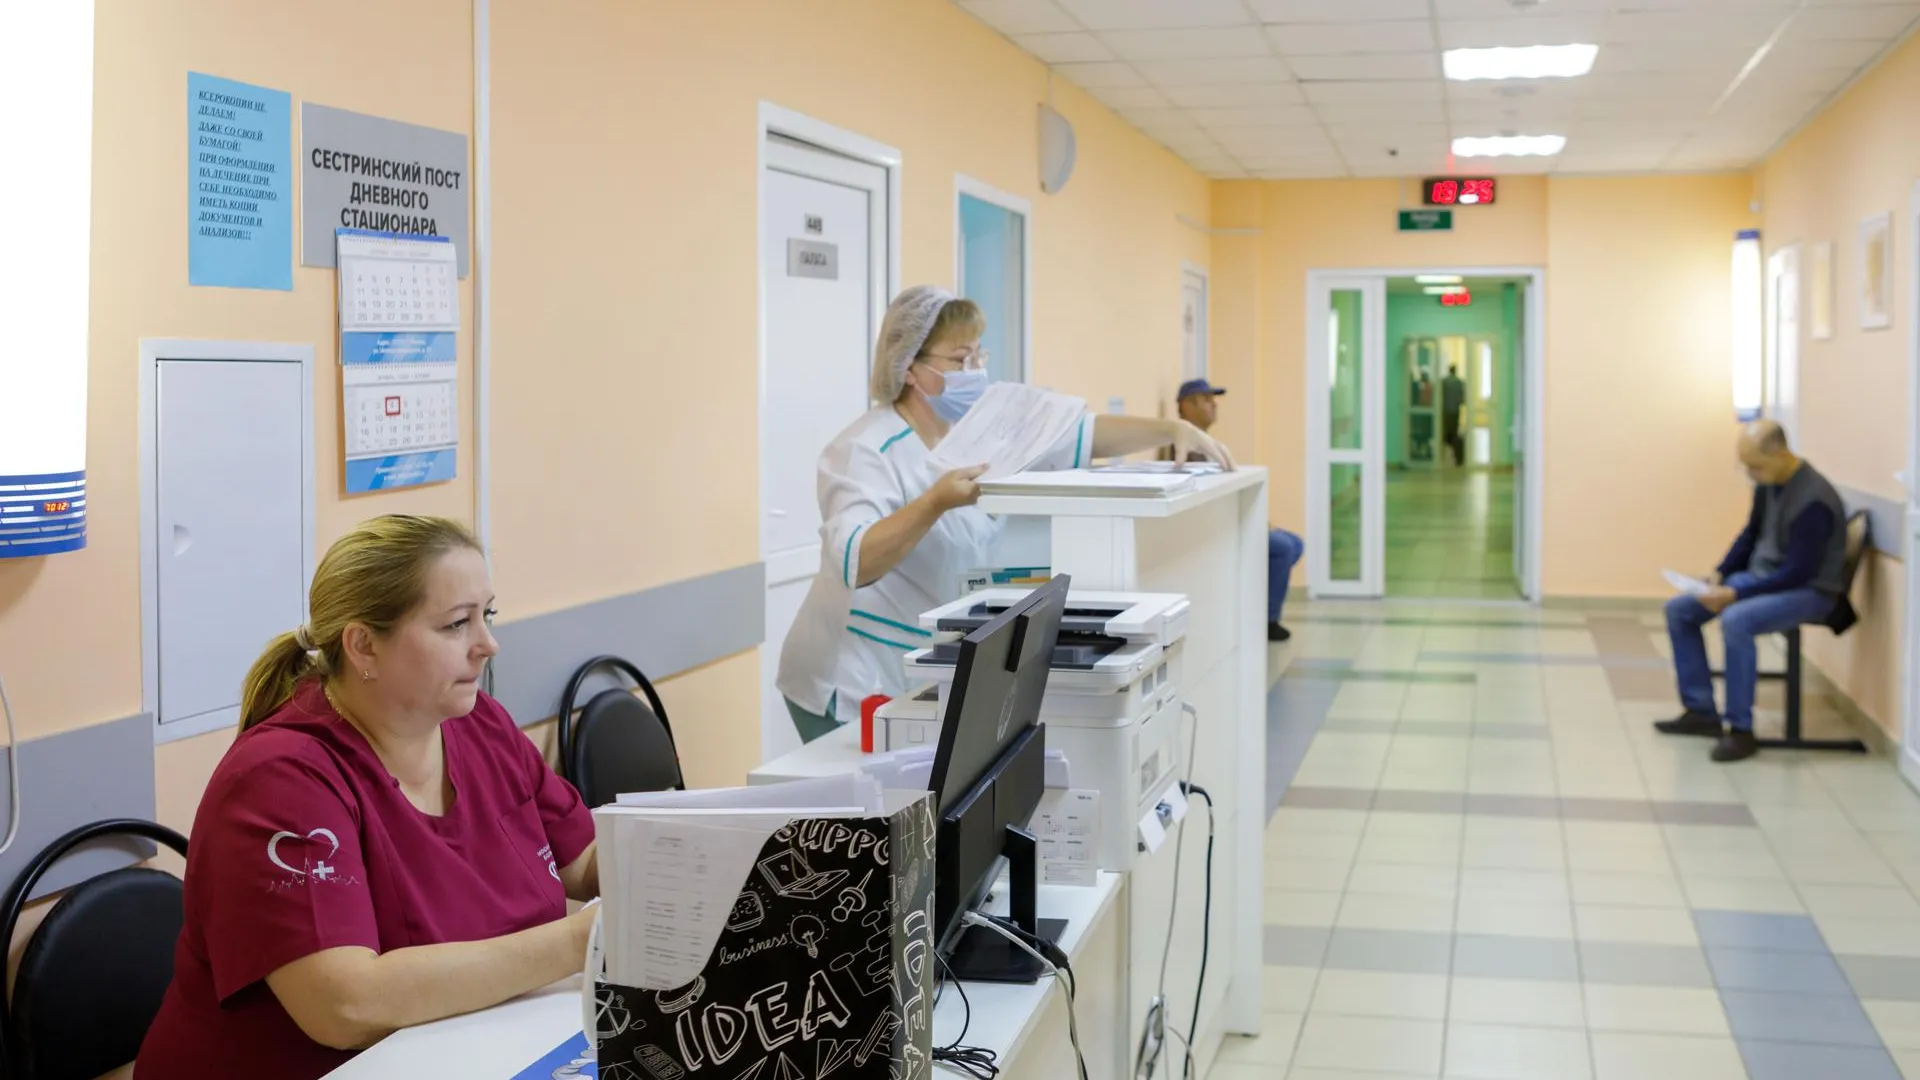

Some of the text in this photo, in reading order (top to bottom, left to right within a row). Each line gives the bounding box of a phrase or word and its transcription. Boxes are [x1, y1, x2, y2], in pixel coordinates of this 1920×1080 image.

[199, 90, 265, 111] КСЕРОКОПИИ НЕ
[198, 104, 236, 120] ДЕЛАЕМ!
[198, 121, 263, 141] ДАЖЕ СО СВОЕЙ
[199, 135, 241, 151] БУМАГОЙ!
[199, 152, 217, 164] ПРИ
[199, 167, 270, 186] НА ЛЕЧЕНИЕ ПРИ
[312, 147, 461, 190] СЕСТРИНСКИЙ ПОСТ
[199, 182, 278, 201] СЕБЕ НЕОБХОДИМО
[350, 182, 429, 210] ДНЕВНОГО
[199, 196, 258, 212] ИМЕТЬ КОПИИ
[198, 211, 263, 227] ДОКУМЕНТОВ И
[340, 207, 438, 236] СТАЦИОНАРА
[718, 933, 789, 968] business
[675, 969, 852, 1073] IDEA
